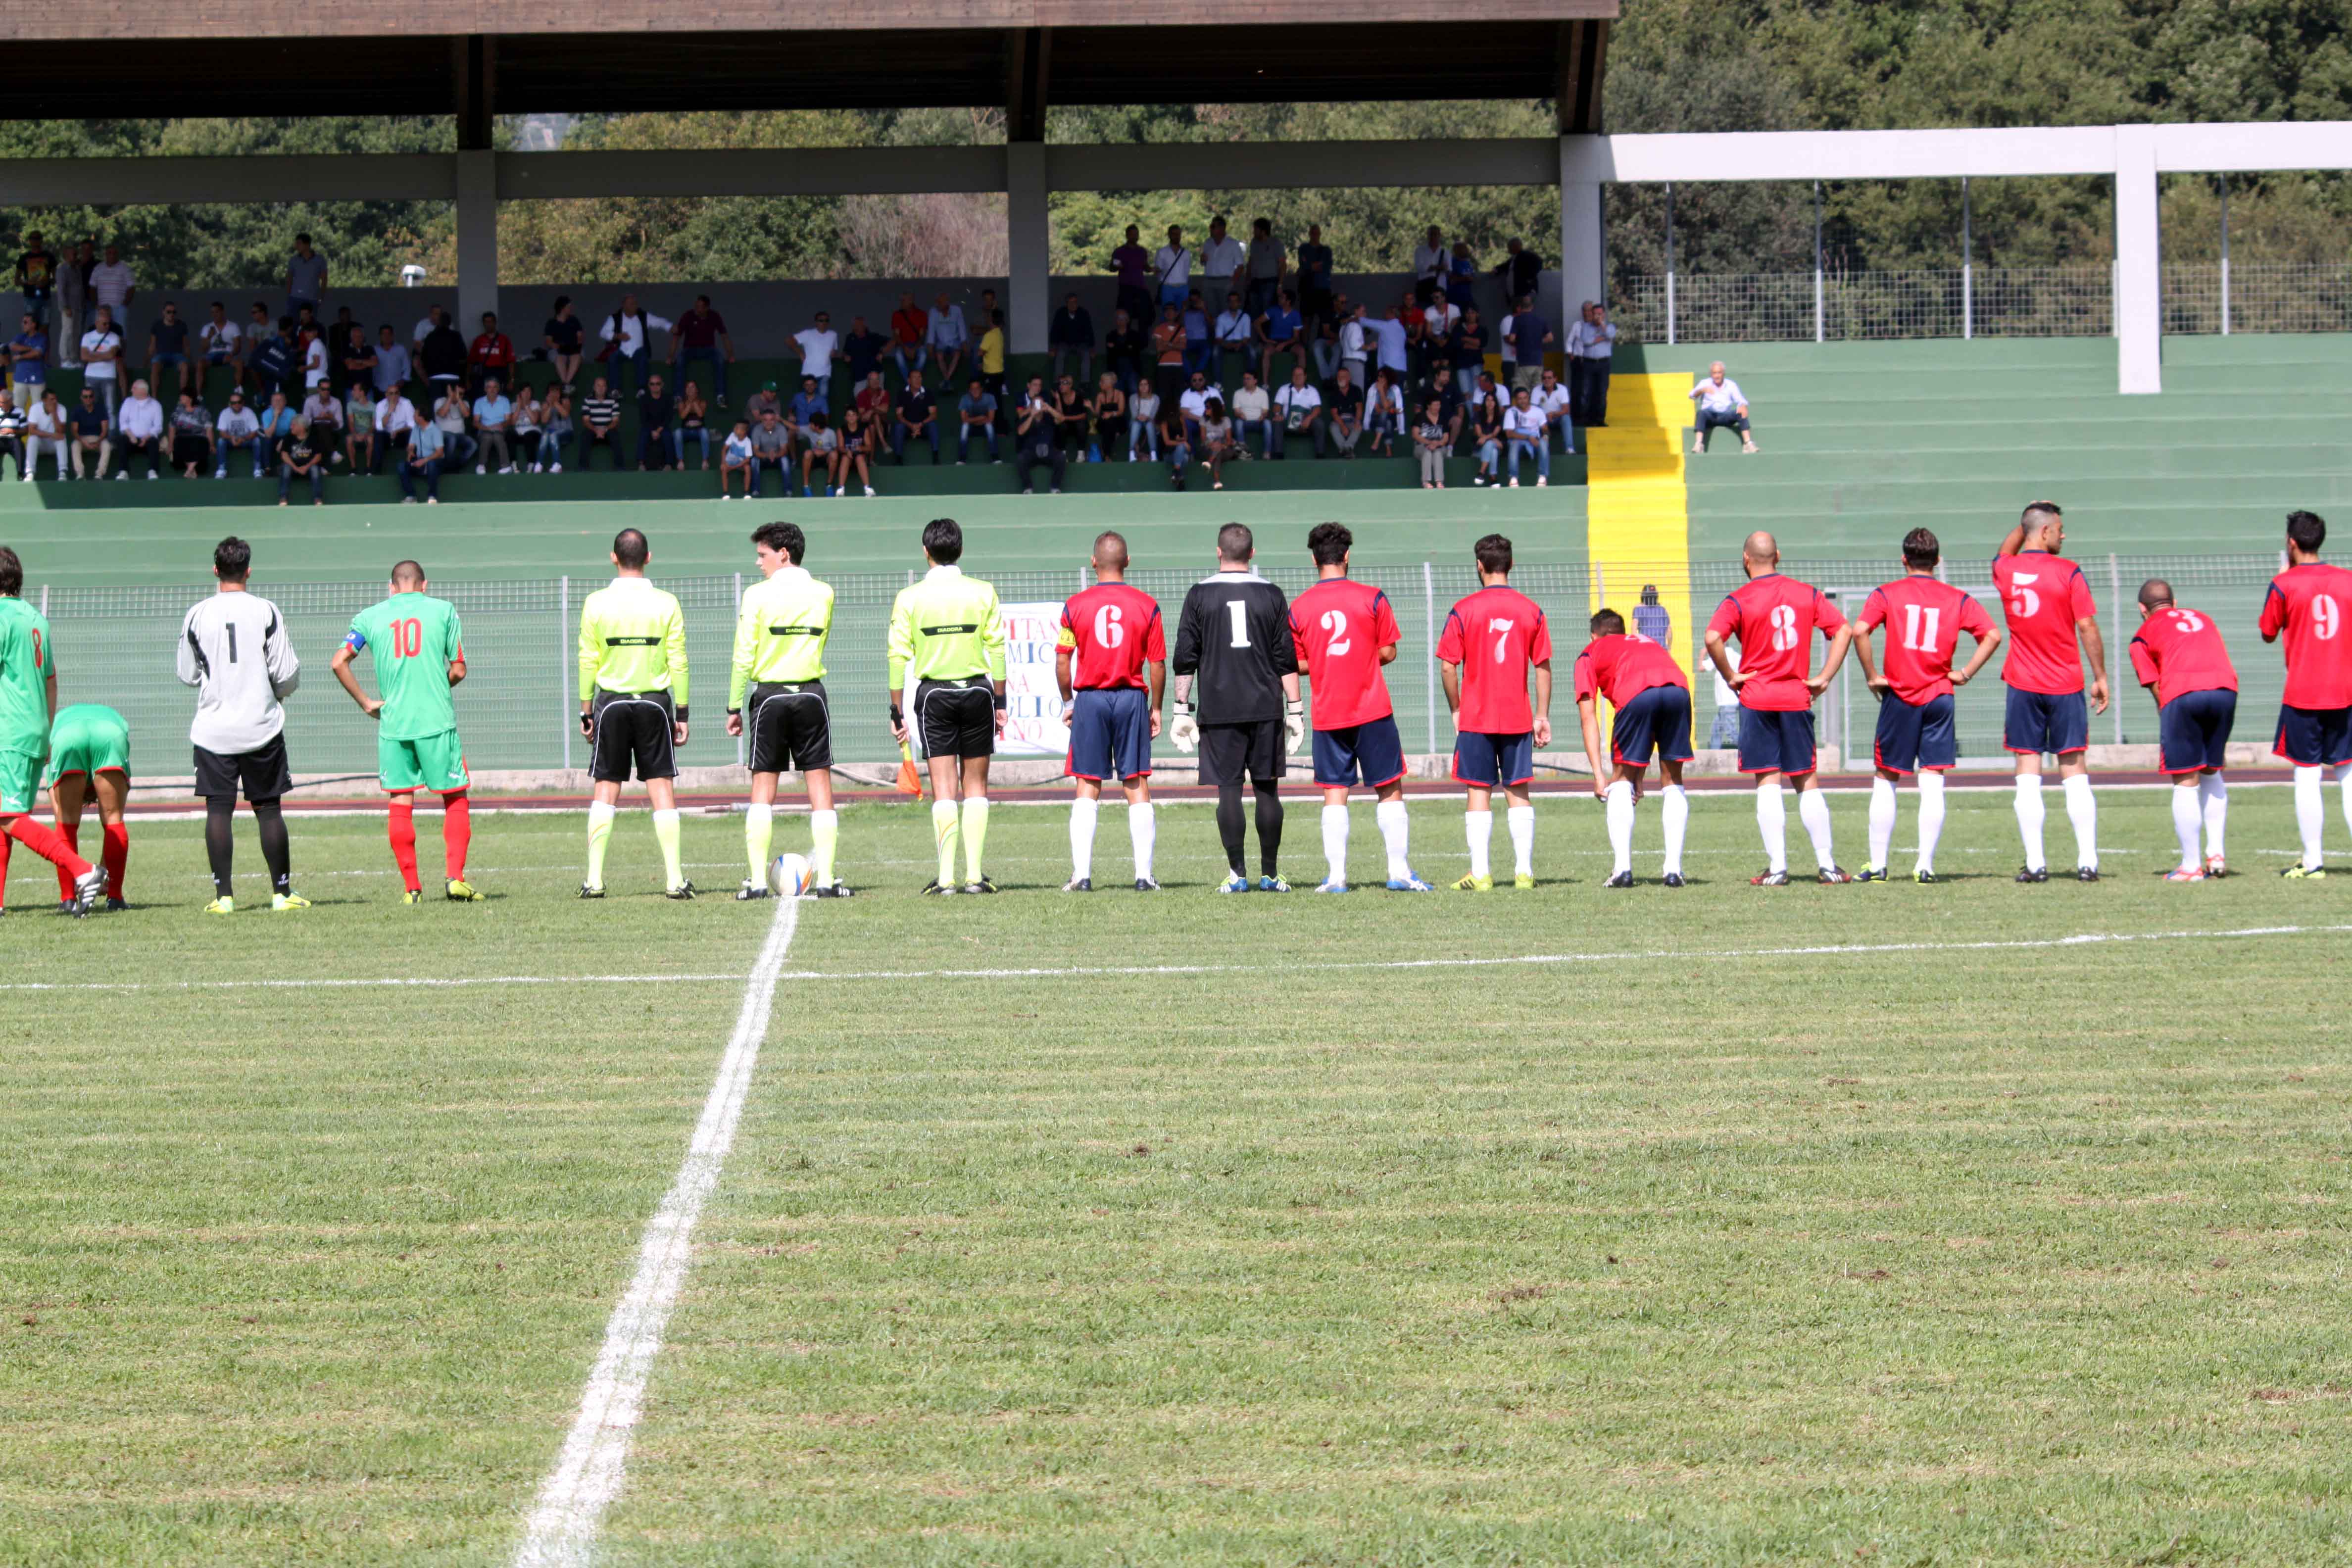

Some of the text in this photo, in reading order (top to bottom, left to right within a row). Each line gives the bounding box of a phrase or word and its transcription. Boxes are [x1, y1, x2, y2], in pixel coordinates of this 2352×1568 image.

[2011, 572, 2039, 617] 5
[2312, 594, 2339, 639] 9
[226, 623, 238, 663] 1
[390, 617, 422, 658] 10
[1003, 618, 1060, 640] ITAN
[1095, 605, 1123, 648] 6
[1226, 600, 1251, 647] 1
[1321, 610, 1350, 656] 2
[1489, 618, 1514, 663] 7
[1771, 605, 1798, 651] 8
[1904, 604, 1940, 652] 11
[2167, 609, 2204, 632] 3
[32, 628, 43, 668] 8
